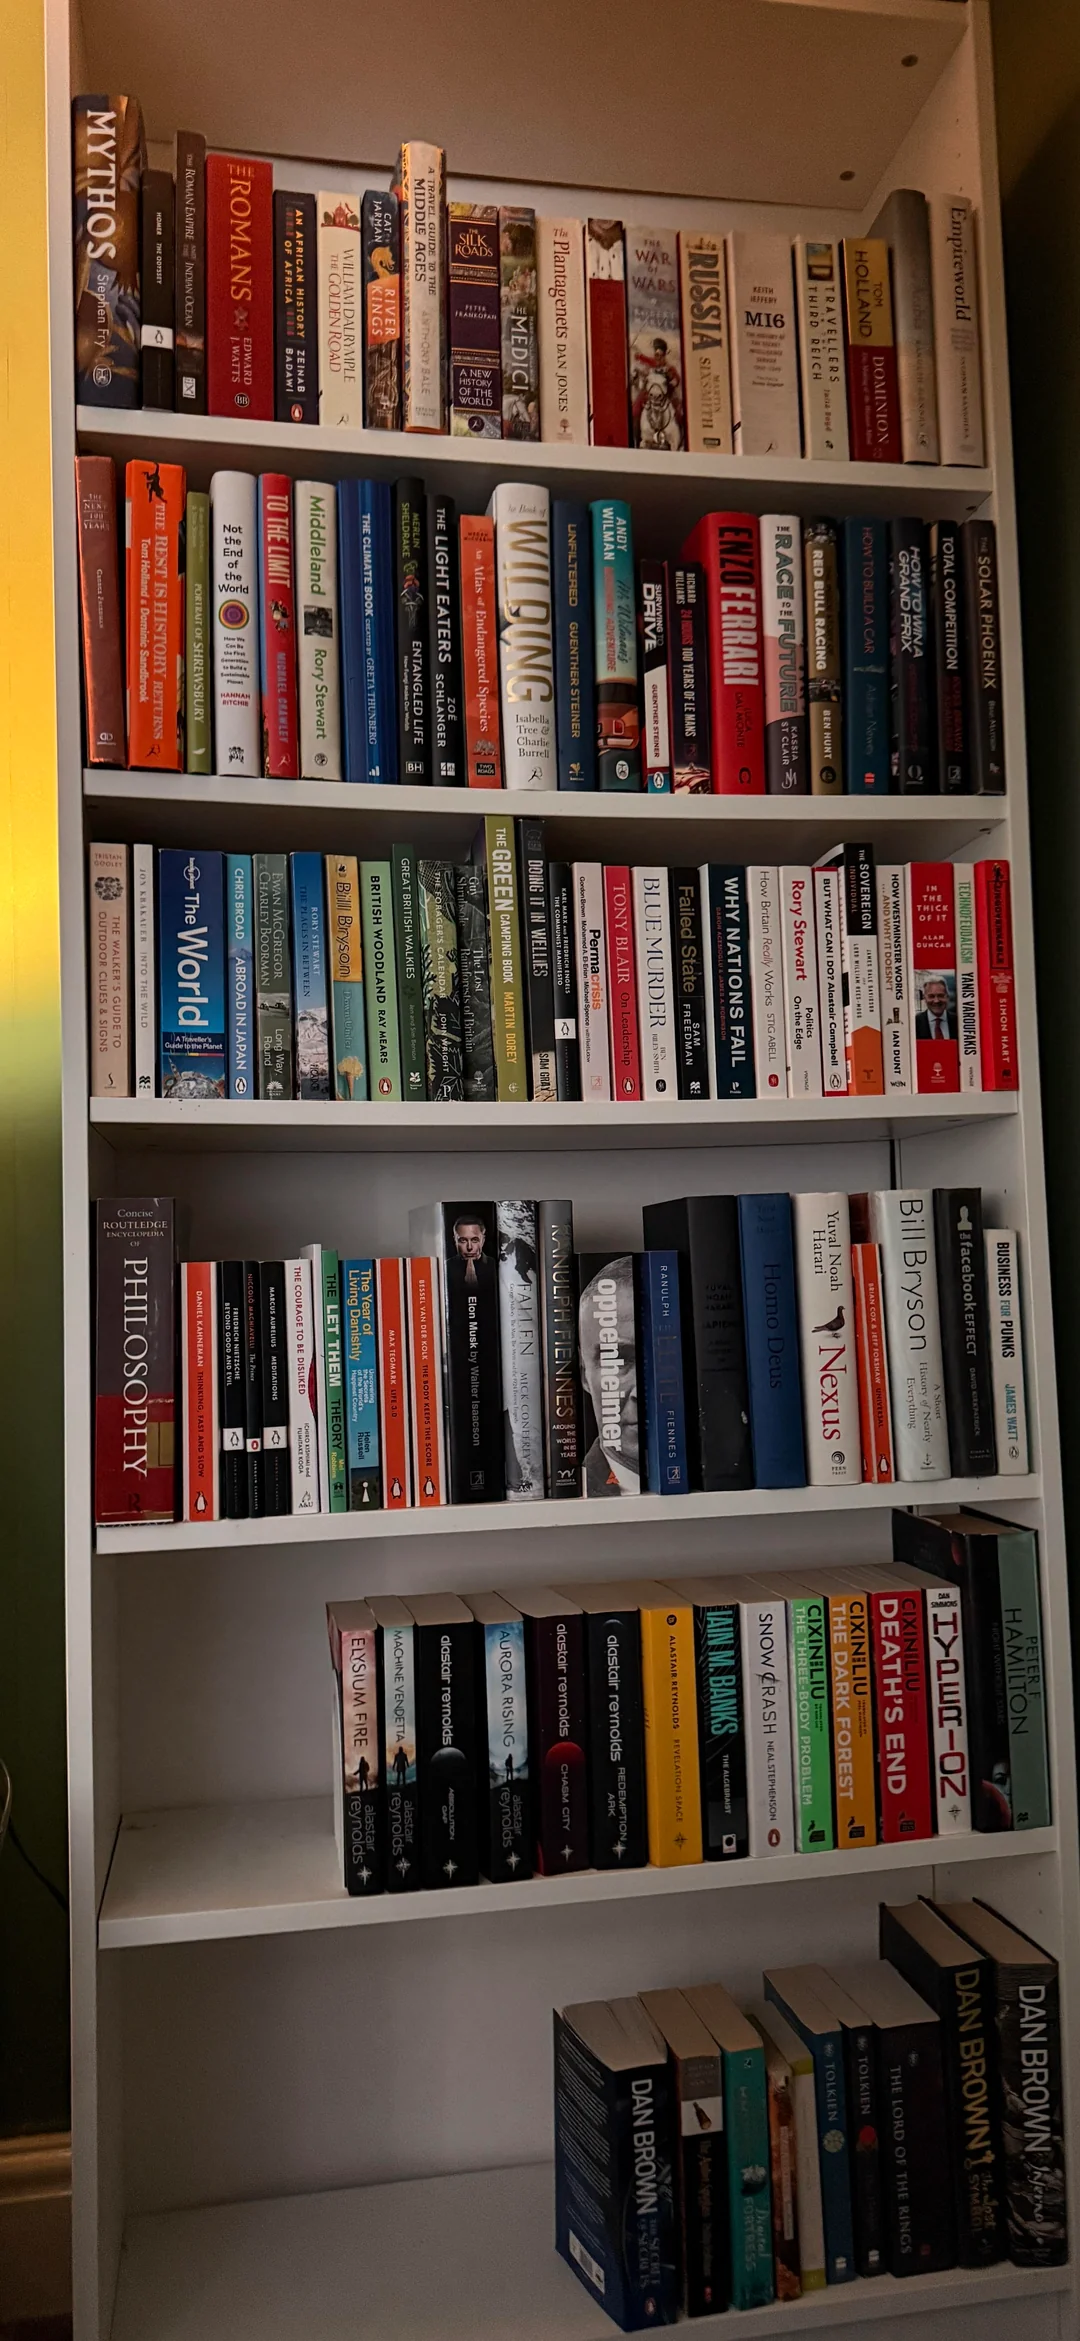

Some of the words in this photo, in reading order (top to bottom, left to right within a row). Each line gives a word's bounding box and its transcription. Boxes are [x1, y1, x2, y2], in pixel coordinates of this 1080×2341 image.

[87, 110, 117, 259] MYTHOS
[414, 179, 426, 234] MIDDLE
[230, 180, 251, 301] ROMANS
[296, 209, 302, 225] AN
[374, 201, 382, 242] JARMAN
[459, 234, 486, 246] SILK
[285, 240, 292, 255] OF
[415, 242, 426, 282] AGES
[455, 245, 493, 257] ROADS
[636, 250, 671, 265] WAR
[947, 207, 971, 321] Empireworld
[97, 274, 109, 324] Stephen
[296, 280, 304, 337] HISTORY
[549, 240, 570, 339] Plantagenets
[632, 276, 676, 293] WARS
[688, 252, 722, 351] RUSSIA
[808, 287, 819, 328] THIRD
[855, 251, 872, 338] HOLLAND
[372, 286, 382, 336] KINGS
[385, 289, 396, 336] RIVER
[745, 311, 785, 328] MI6
[825, 287, 839, 383] TRAVELLERS
[101, 329, 109, 348] Fry
[243, 337, 252, 385] EDWARD
[511, 316, 529, 391] MEDICI
[557, 344, 566, 367] DAN
[811, 339, 821, 380] REICH
[286, 348, 294, 392] BADAWI
[297, 350, 305, 393] ZEINAB
[460, 378, 492, 388] HISTORY
[470, 370, 491, 378] NEW
[556, 375, 568, 412] JONES
[459, 397, 493, 406] WORLD
[872, 356, 889, 444] DOMINION
[222, 524, 243, 534] Not
[266, 496, 288, 512] TO
[155, 535, 168, 575] REST
[223, 548, 243, 558] End
[224, 536, 241, 546] the
[310, 496, 326, 596] Middleland
[602, 508, 614, 561] WILMAN
[616, 517, 626, 552] ANDY
[718, 526, 754, 586] ENZO
[942, 537, 953, 575] TOTAL
[225, 572, 242, 582] the
[228, 559, 239, 570] of
[269, 552, 290, 588] LIMIT
[363, 537, 372, 583] CLIMATE
[435, 536, 449, 590] LIGHT
[568, 524, 577, 607] UNFILTERED
[776, 534, 794, 600] RACE
[813, 550, 823, 574] RED
[978, 556, 991, 609] SOLAR
[218, 584, 249, 595] World
[503, 520, 554, 703] WILDING
[814, 577, 824, 607] BULL
[153, 603, 167, 674] HISTORY
[436, 594, 451, 663] EATERS
[643, 584, 656, 652] DRIVE
[720, 587, 759, 686] FERRARI
[815, 611, 826, 670] RACING
[944, 578, 958, 669] COMPETITION
[314, 649, 328, 681] Rory
[474, 610, 486, 683] Endangered
[778, 619, 797, 712] FUTURE
[981, 614, 996, 689] PHOENIX
[193, 642, 204, 723] SHREWSBURY
[412, 641, 422, 715] ENTANGLED
[314, 686, 328, 740] Stewart
[516, 715, 549, 724] Isabella
[235, 868, 243, 899] CHRIS
[336, 882, 351, 911] Bill
[492, 849, 514, 912] GREEN
[644, 879, 660, 931] BLUE
[724, 877, 739, 921] WHY
[789, 881, 805, 916] Rory
[860, 864, 872, 930] SOVEREIGN
[235, 903, 244, 939] BROAD
[401, 858, 410, 892] GREAT
[406, 938, 414, 979] WALKIES
[614, 884, 627, 931] TONY
[679, 886, 696, 940] Failed
[260, 928, 269, 986] BOORMAN
[338, 916, 352, 976] Bryson
[500, 914, 512, 960] CAMPING
[616, 937, 630, 983] BLAIR
[793, 920, 807, 981] Stewart
[177, 927, 208, 1026] World
[236, 957, 245, 1008] ABROAD
[373, 929, 386, 1004] WOODLAND
[502, 961, 513, 983] BOOK
[646, 937, 666, 1028] MURDER
[681, 945, 697, 993] State
[727, 925, 743, 1019] NATIONS
[961, 973, 975, 1004] YANIS
[504, 992, 515, 1028] MARTIN
[683, 1004, 693, 1065] FREEDMAN
[236, 1028, 246, 1070] JAPAN
[506, 1034, 517, 1064] DOREY
[730, 1026, 746, 1068] FAIL
[830, 1022, 838, 1066] Campbell
[893, 1050, 901, 1075] DUNT
[103, 1221, 168, 1229] ROUTLEDGE
[118, 1209, 153, 1218] Concise
[900, 1200, 925, 1240] Bill
[813, 1230, 827, 1274] Harari
[997, 1242, 1010, 1296] BUSINESS
[327, 1304, 338, 1335] LET
[468, 1296, 476, 1326] Elon
[518, 1283, 534, 1355] FALLEN
[901, 1251, 927, 1350] Bryson
[349, 1311, 360, 1361] Danishly
[469, 1329, 477, 1348] Musk
[1000, 1320, 1015, 1358] PUNKS
[122, 1257, 148, 1477] PHILOSOPHY
[298, 1358, 306, 1395] DISLIKED
[328, 1341, 340, 1387] THEM
[593, 1279, 624, 1452] oppenheimer
[819, 1345, 847, 1440] Nexus
[331, 1399, 343, 1449] THEORY
[707, 1611, 734, 1646] IAIN
[759, 1613, 775, 1668] SNOW
[350, 1638, 365, 1707] ELYSIUM
[498, 1631, 512, 1692] AURORA
[879, 1599, 903, 1723] DEATH'S
[1004, 1608, 1029, 1736] HAMILTON
[354, 1713, 368, 1747] FIRE
[503, 1698, 515, 1747] RISING
[708, 1674, 737, 1736] BANKS
[933, 1612, 967, 1798] HYPERION
[801, 1736, 812, 1805] PROBLEM
[837, 1717, 853, 1800] FOREST
[886, 1734, 906, 1794] END
[955, 1968, 982, 2031] DAN
[1018, 1985, 1047, 2042] DAN
[632, 2080, 654, 2127] DAN
[825, 2062, 838, 2122] TOLKIEN
[960, 2038, 991, 2149] BROWN
[1021, 2049, 1050, 2152] BROWN
[634, 2132, 657, 2214] BROWN
